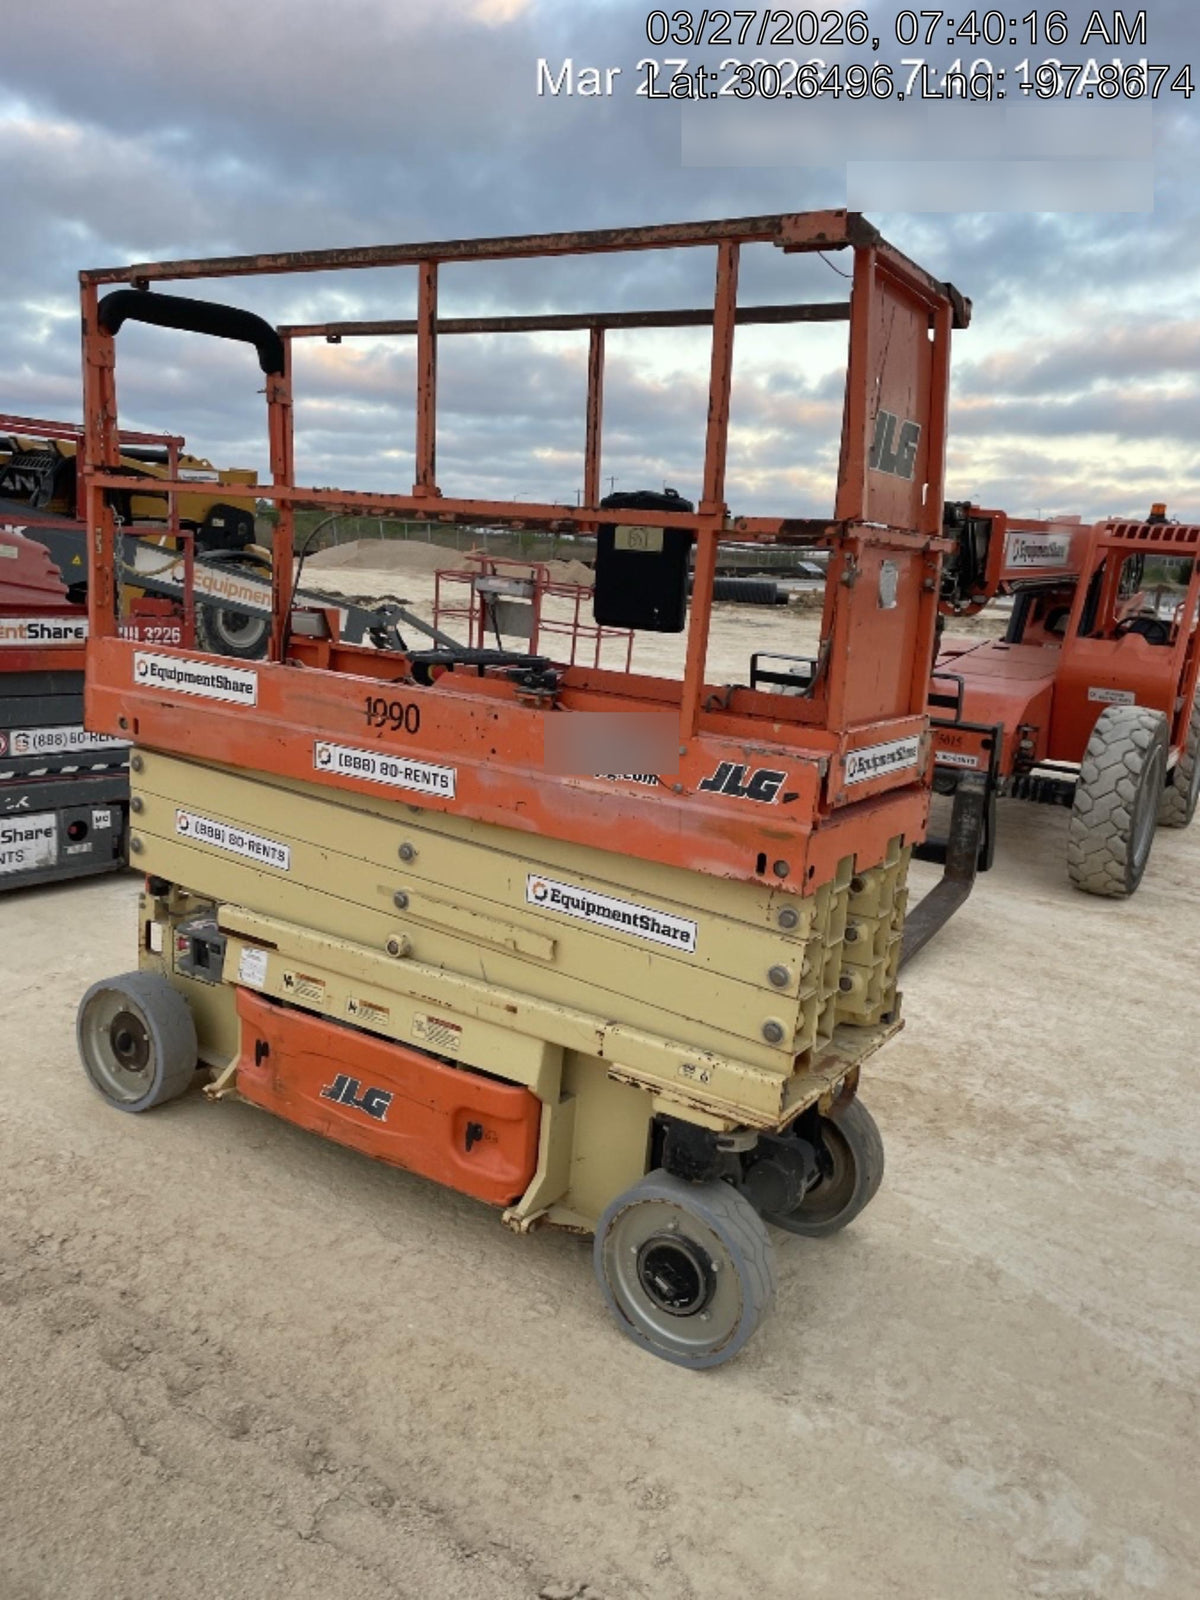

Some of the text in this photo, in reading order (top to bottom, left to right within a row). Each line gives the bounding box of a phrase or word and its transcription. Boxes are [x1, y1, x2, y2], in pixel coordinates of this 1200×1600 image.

[869, 409, 922, 481] JLG
[144, 626, 181, 644] 3226
[150, 665, 254, 695] EquipmentShare
[365, 696, 420, 735] 1990
[339, 753, 449, 788] (888) 80-RENTS
[698, 760, 788, 804] JLG
[1, 827, 54, 844] Share
[229, 833, 285, 862] 80-RENTS
[550, 888, 691, 943] EquipmentShare
[319, 1073, 395, 1122] JLG
